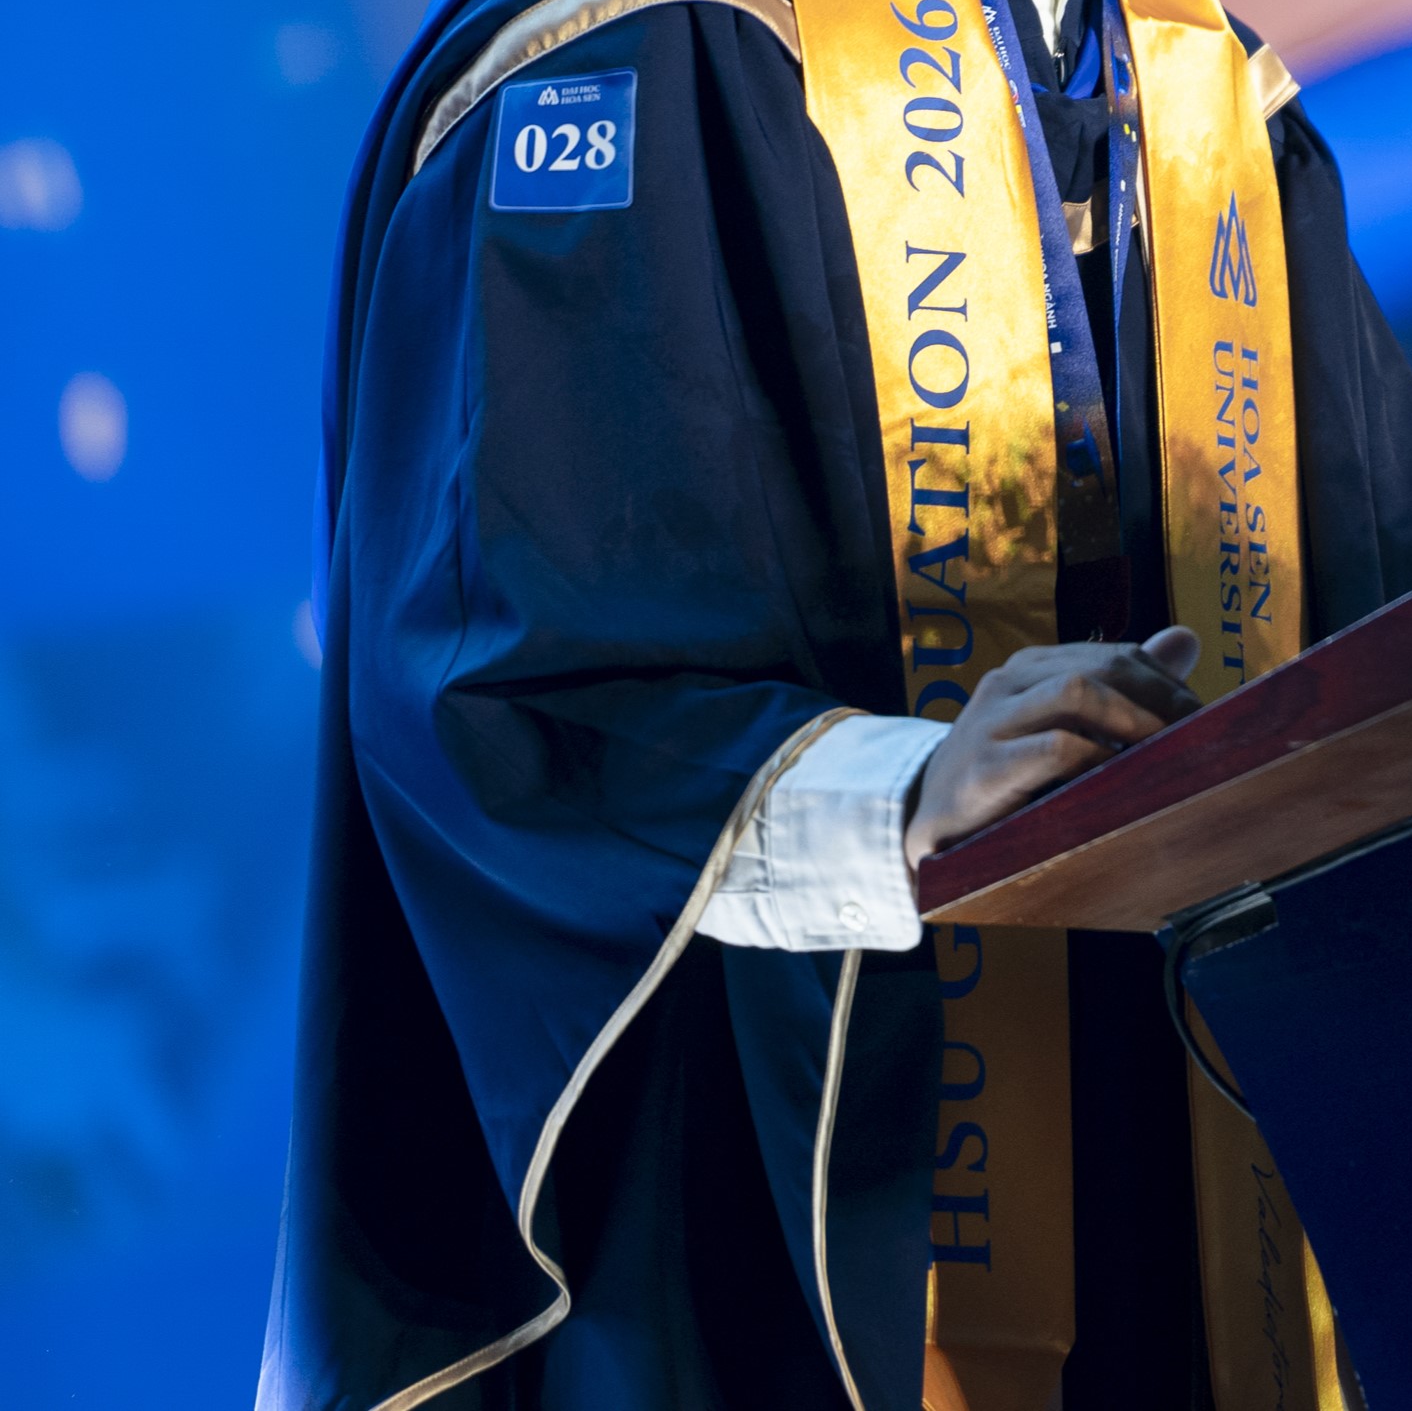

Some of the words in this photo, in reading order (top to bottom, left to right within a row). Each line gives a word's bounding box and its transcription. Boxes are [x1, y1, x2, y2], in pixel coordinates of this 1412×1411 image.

[514, 119, 617, 173] 028
[1241, 344, 1264, 487] HOA
[1213, 339, 1246, 686] UNIVERSIT
[1245, 502, 1273, 625] SEN
[928, 1040, 992, 1273] HSU
